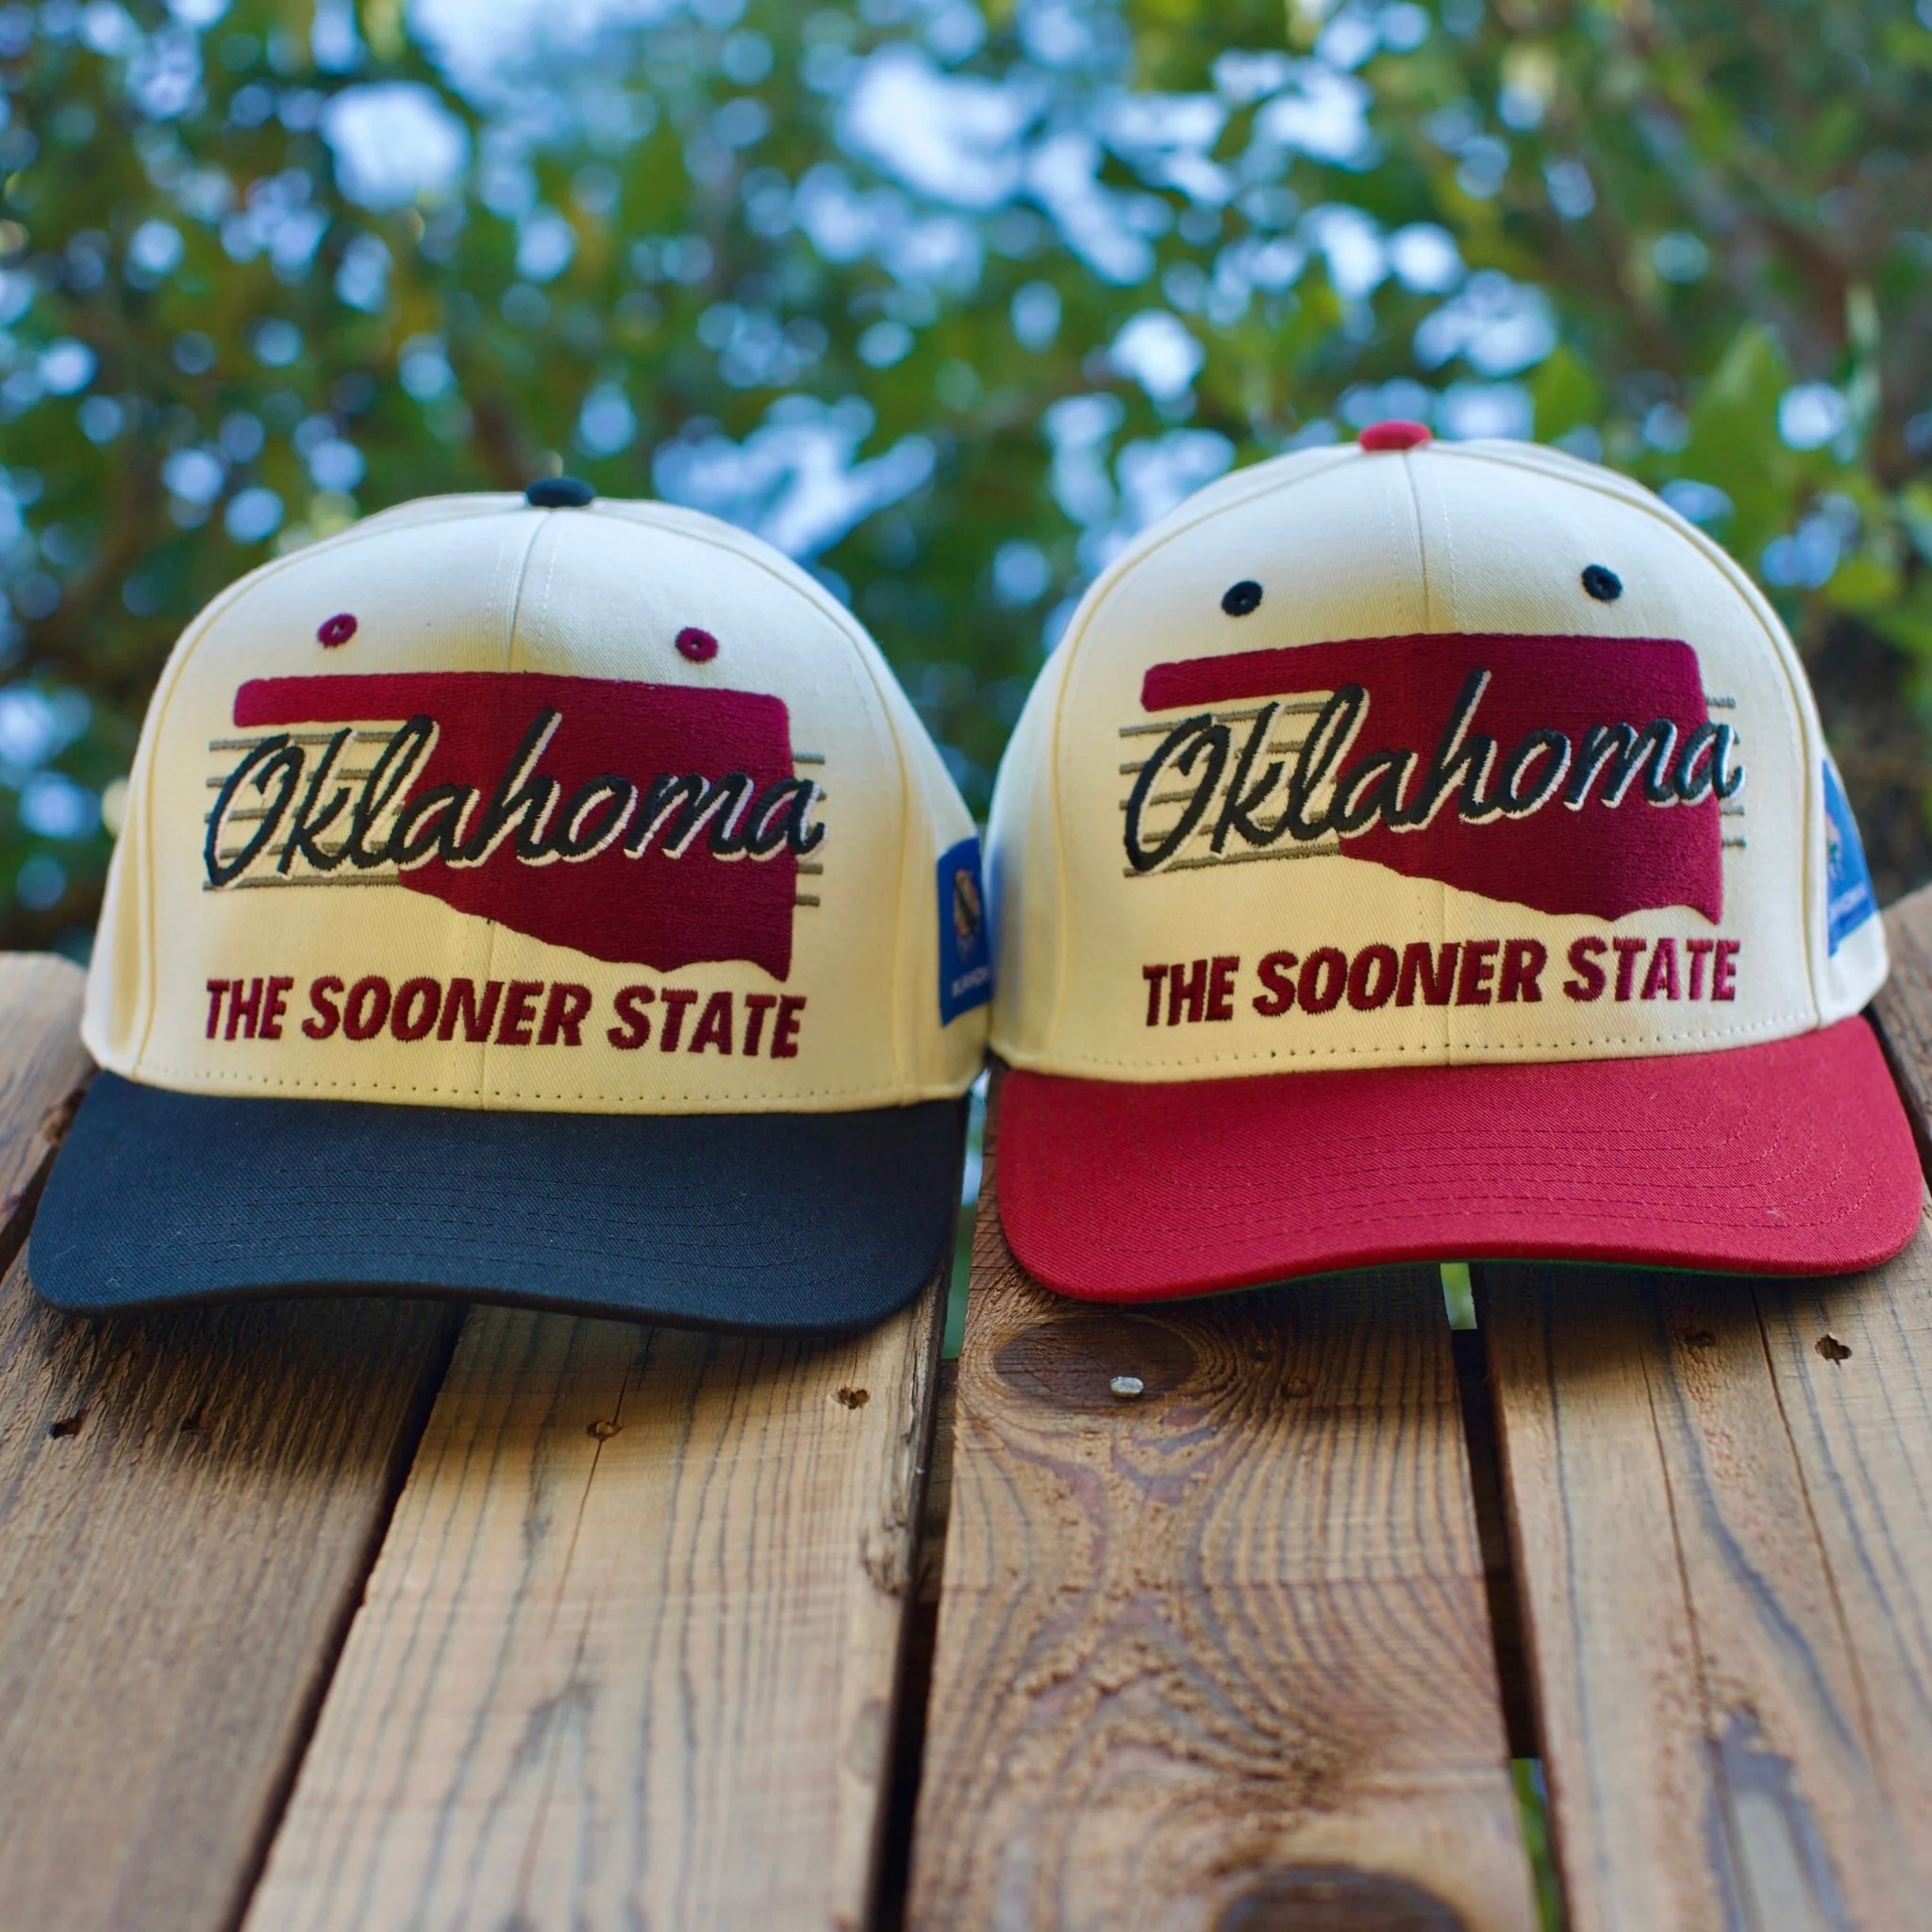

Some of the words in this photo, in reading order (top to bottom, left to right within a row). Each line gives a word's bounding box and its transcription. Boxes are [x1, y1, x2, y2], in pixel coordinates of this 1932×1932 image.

[203, 708, 826, 889] Oklahoma
[1123, 668, 1746, 873] Oklahoma
[206, 975, 294, 1041] THE
[301, 974, 592, 1046] SOONER
[606, 984, 807, 1058] STATE
[1142, 955, 1241, 1026] THE
[1252, 939, 1548, 1017] SOONER
[1563, 936, 1740, 1003] STATE
